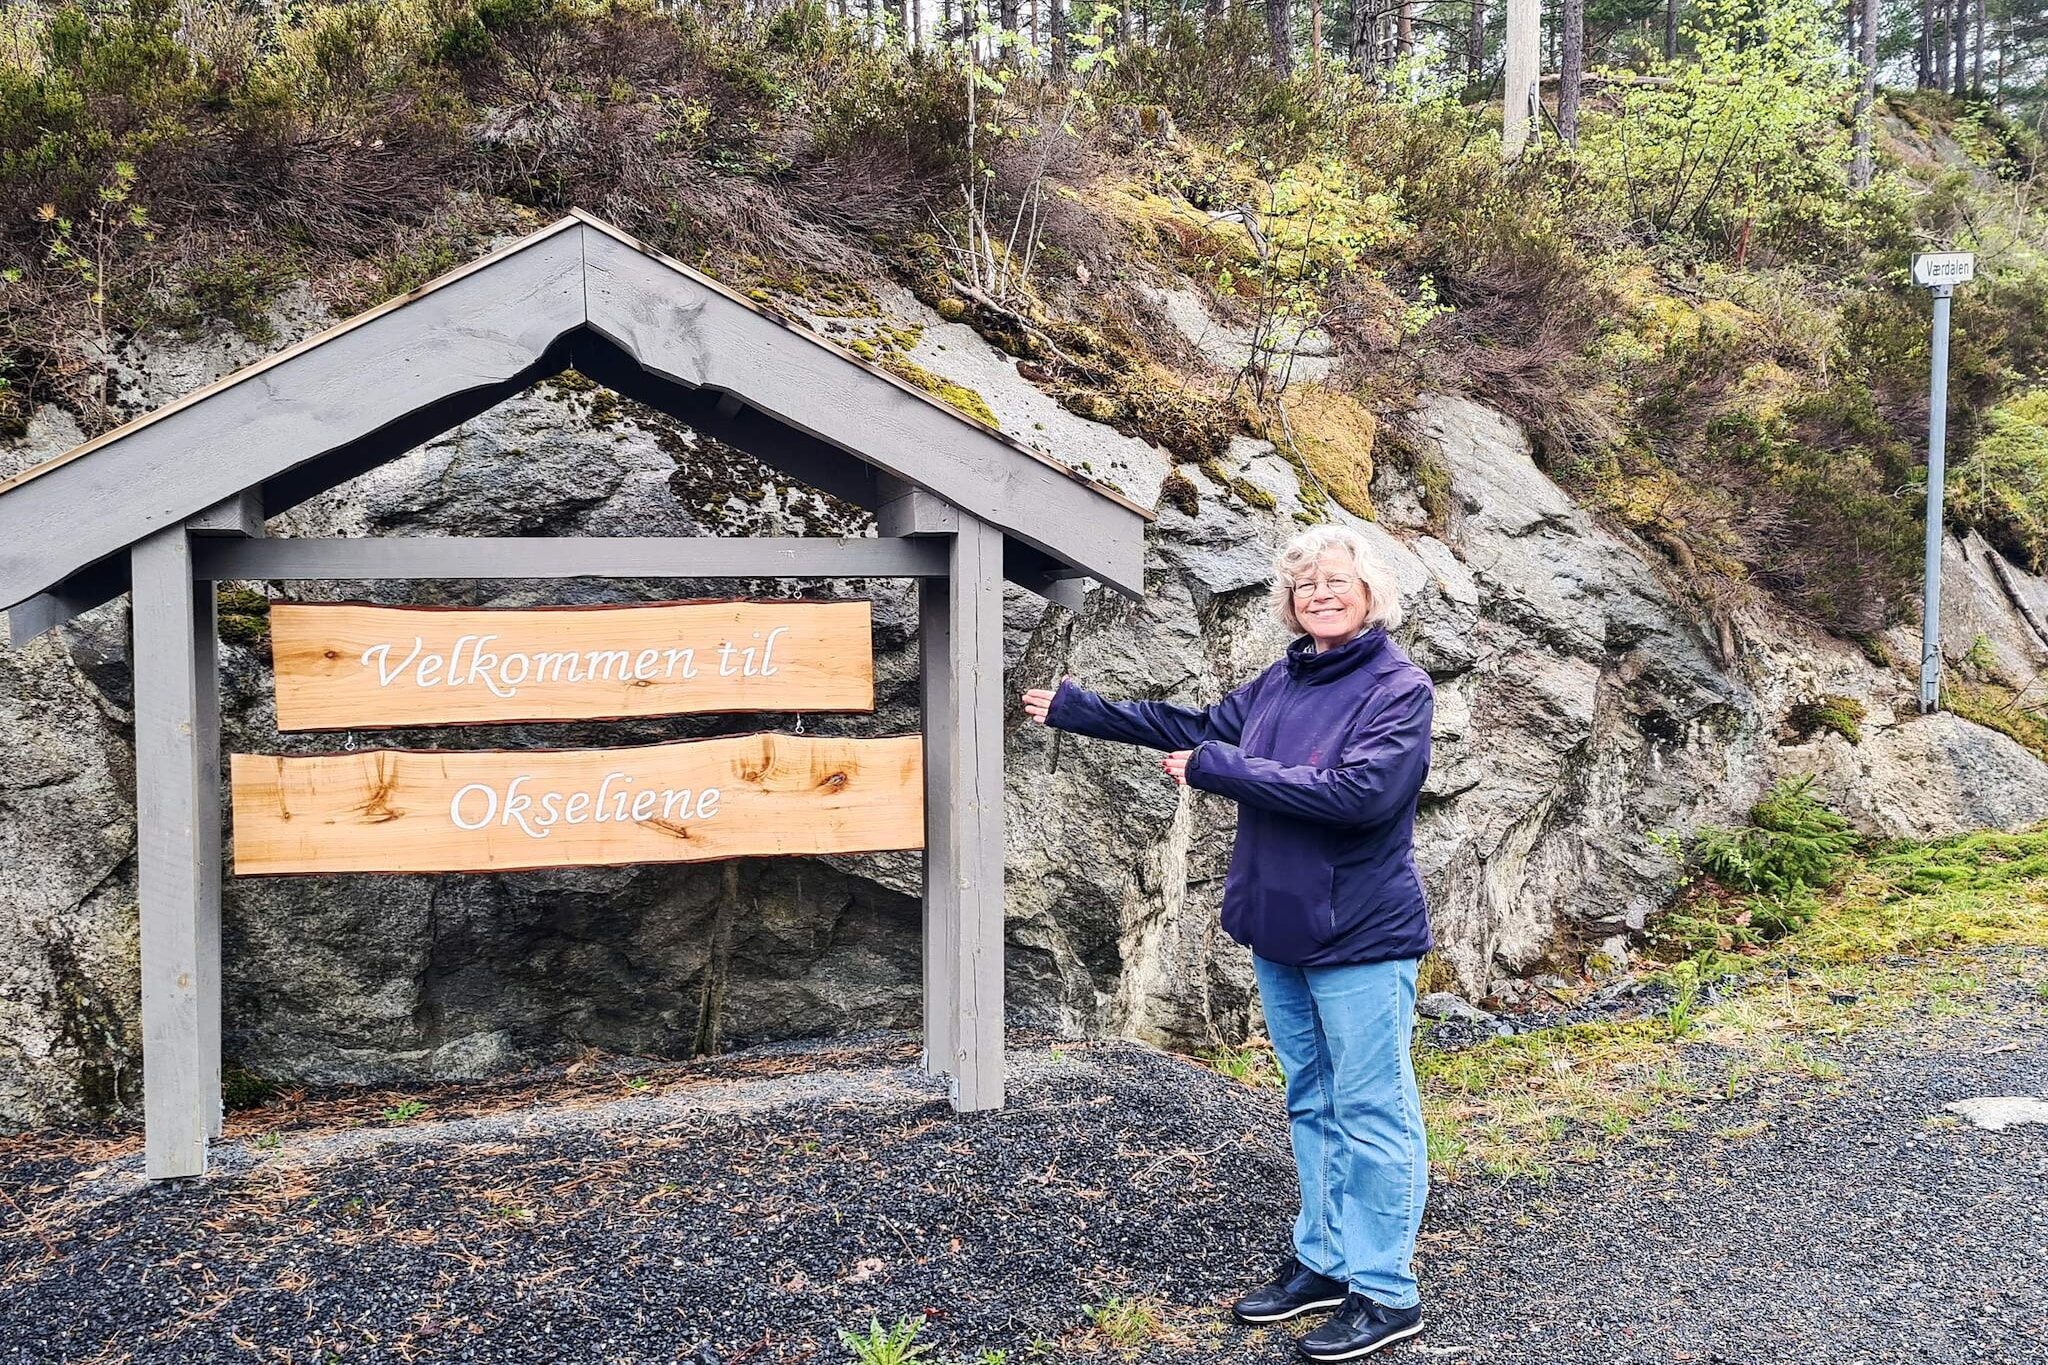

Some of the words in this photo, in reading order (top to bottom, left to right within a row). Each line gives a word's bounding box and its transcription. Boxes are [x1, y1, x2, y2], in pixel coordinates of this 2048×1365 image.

[1926, 259, 1969, 276] Værdalen
[361, 633, 696, 698] Velkommen
[717, 626, 790, 678] til
[450, 772, 722, 839] Okseliene
